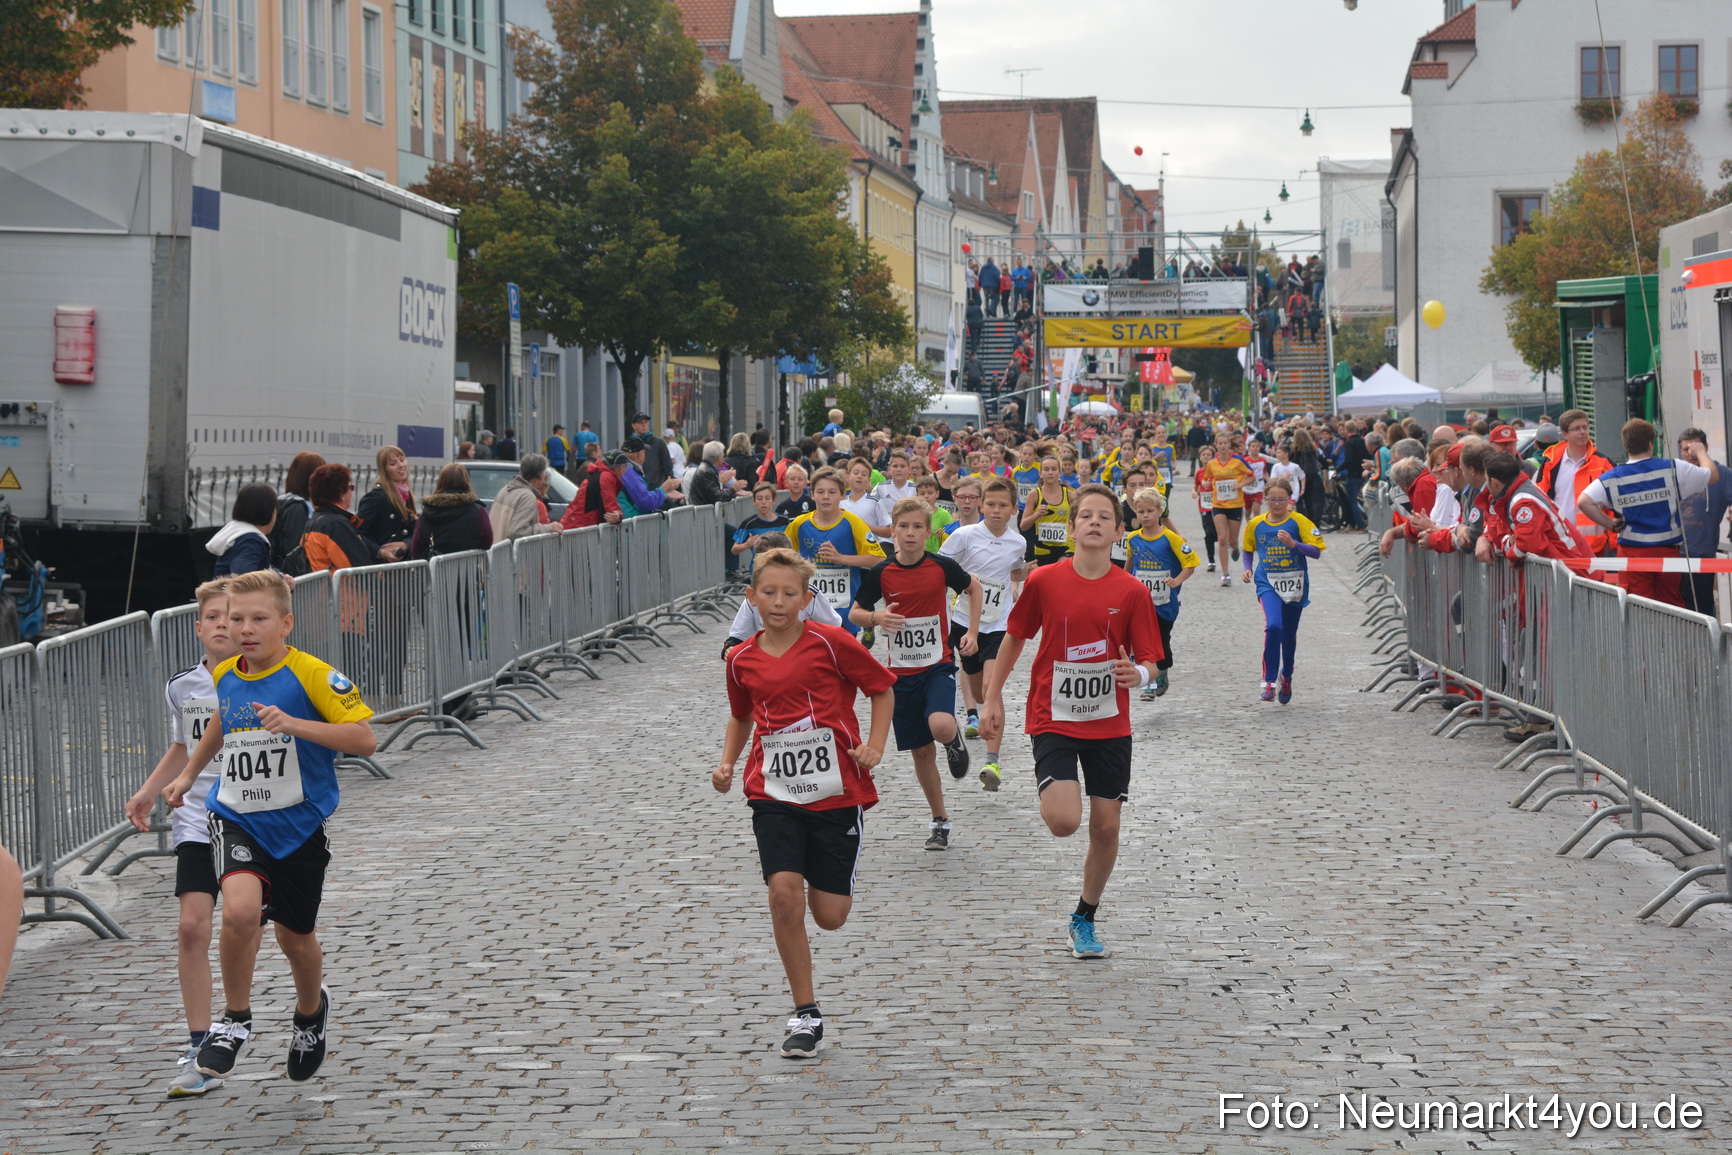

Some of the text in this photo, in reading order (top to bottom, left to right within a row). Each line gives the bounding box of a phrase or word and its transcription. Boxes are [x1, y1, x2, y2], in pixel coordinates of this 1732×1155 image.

[1103, 289, 1209, 300] BMW EfficientDynamics
[399, 277, 446, 347] BOCK
[1111, 323, 1182, 340] START
[1155, 353, 1165, 361] 22
[1617, 490, 1671, 505] SEG-LEITER
[1042, 529, 1064, 540] 4002
[1274, 579, 1302, 593] 4024
[904, 621, 931, 629] Neumarkt
[894, 628, 936, 649] 4034
[900, 652, 932, 661] Jonathan
[1078, 647, 1096, 656] DEHN
[1055, 666, 1108, 675] PARTL Neumarkt
[1059, 674, 1112, 699] 4000
[184, 707, 204, 715] PARTL
[1071, 704, 1100, 714] Fabian
[224, 737, 279, 750] PARTL Neumarkt
[763, 737, 820, 750] PARTL Neumarkt
[226, 748, 287, 782] 4047
[769, 746, 831, 778] 4028
[242, 788, 271, 801] Philp
[785, 783, 819, 795] Tobias
